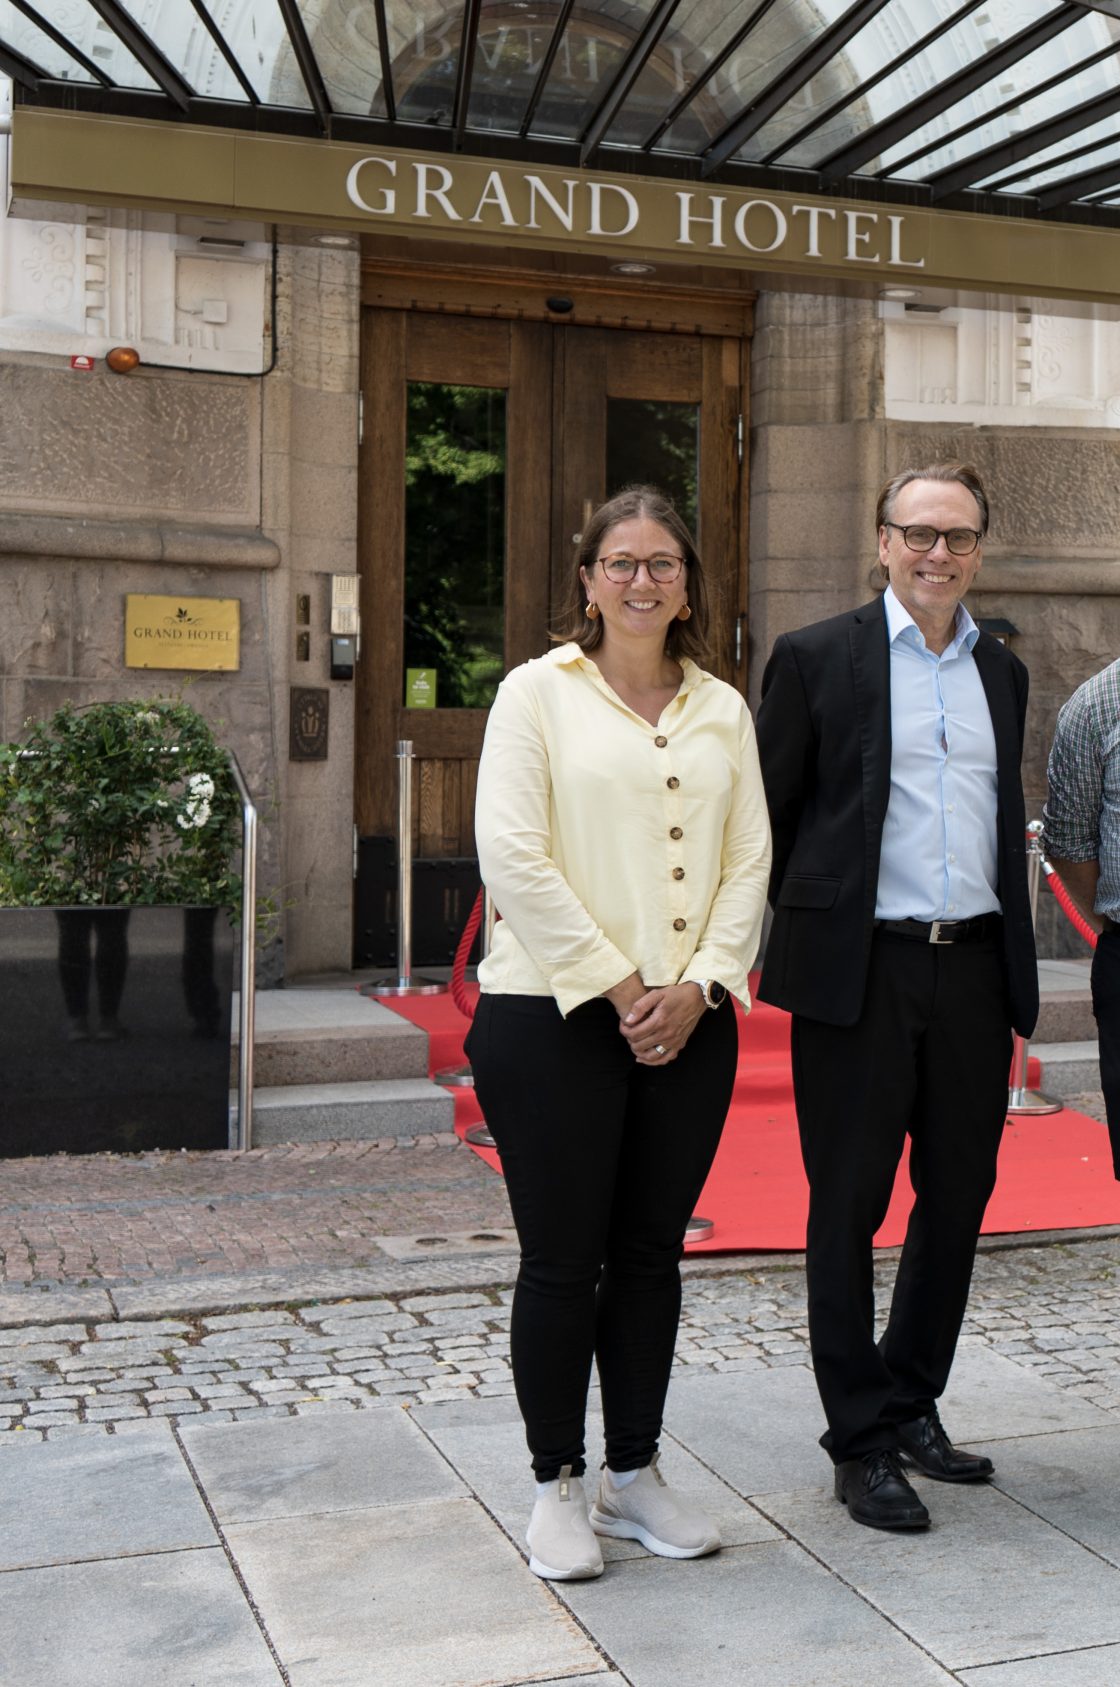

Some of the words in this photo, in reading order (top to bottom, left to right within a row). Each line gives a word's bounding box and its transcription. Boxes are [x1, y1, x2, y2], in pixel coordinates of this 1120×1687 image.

[346, 157, 639, 236] GRAND
[675, 191, 925, 267] HOTEL
[133, 627, 182, 639] GRAND
[188, 630, 232, 641] HOTEL
